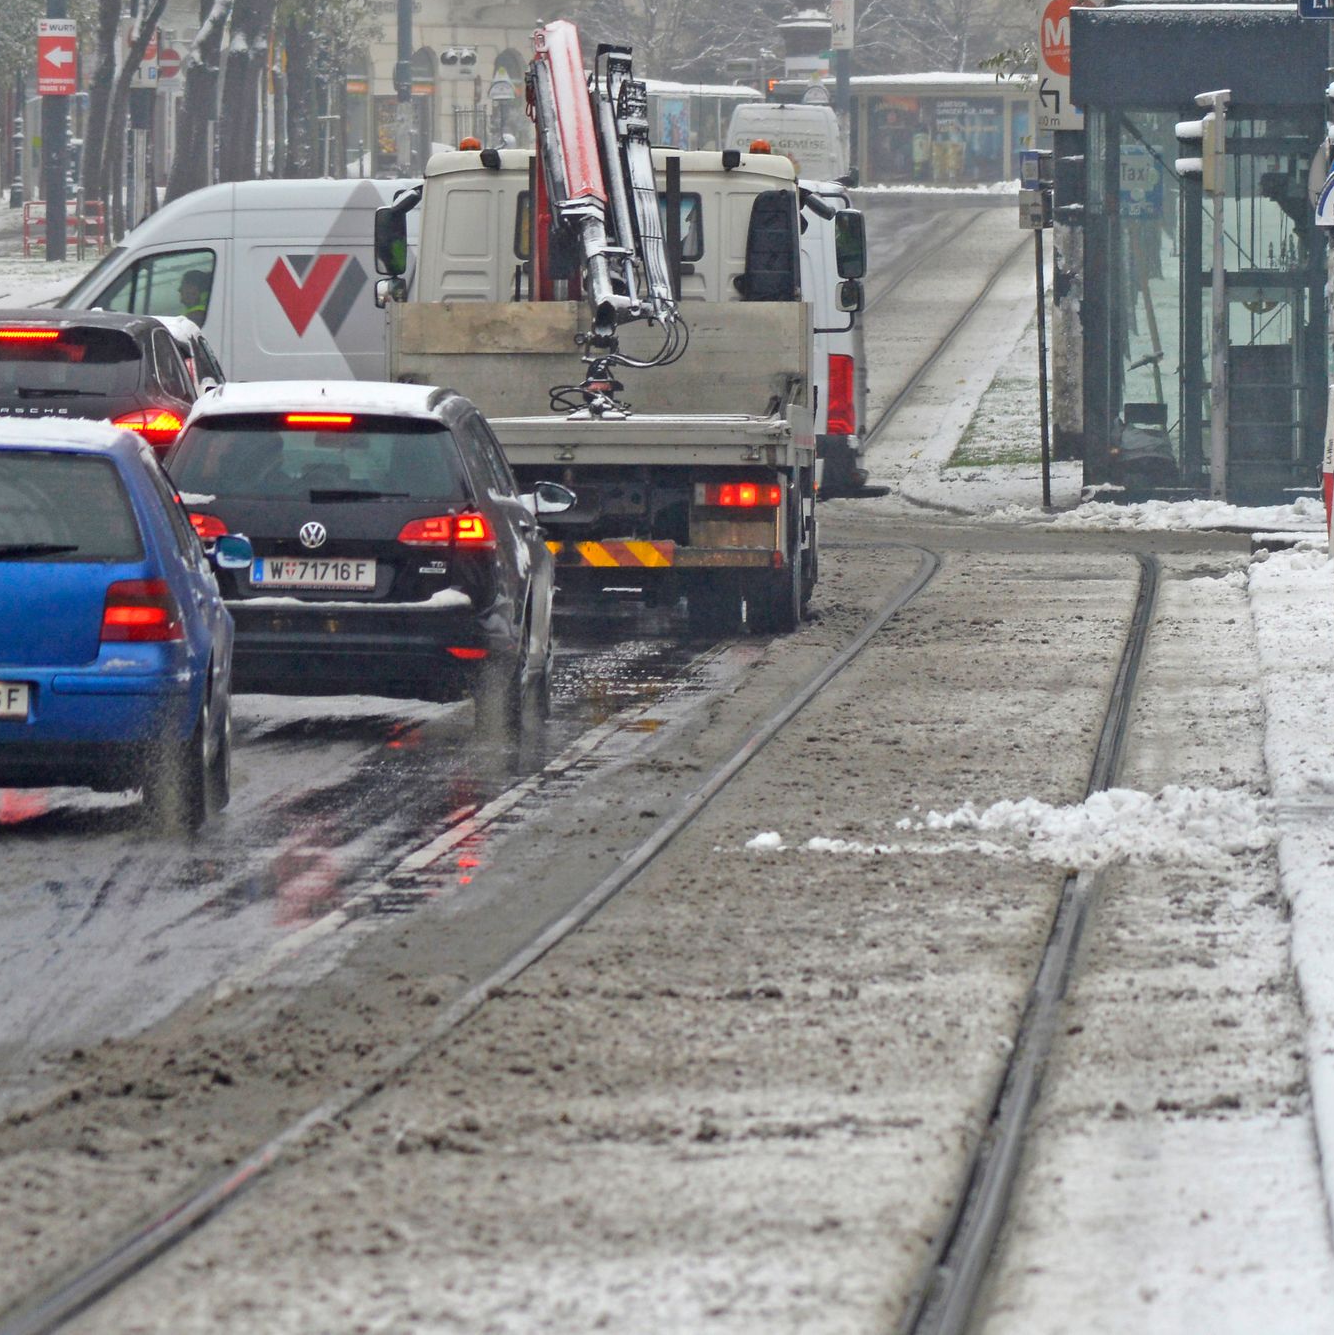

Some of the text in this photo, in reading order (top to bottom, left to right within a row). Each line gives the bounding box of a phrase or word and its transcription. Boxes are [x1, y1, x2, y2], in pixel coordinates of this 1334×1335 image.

[270, 561, 283, 580] W
[298, 561, 351, 580] 71716
[356, 563, 367, 581] F
[7, 688, 20, 710] F
